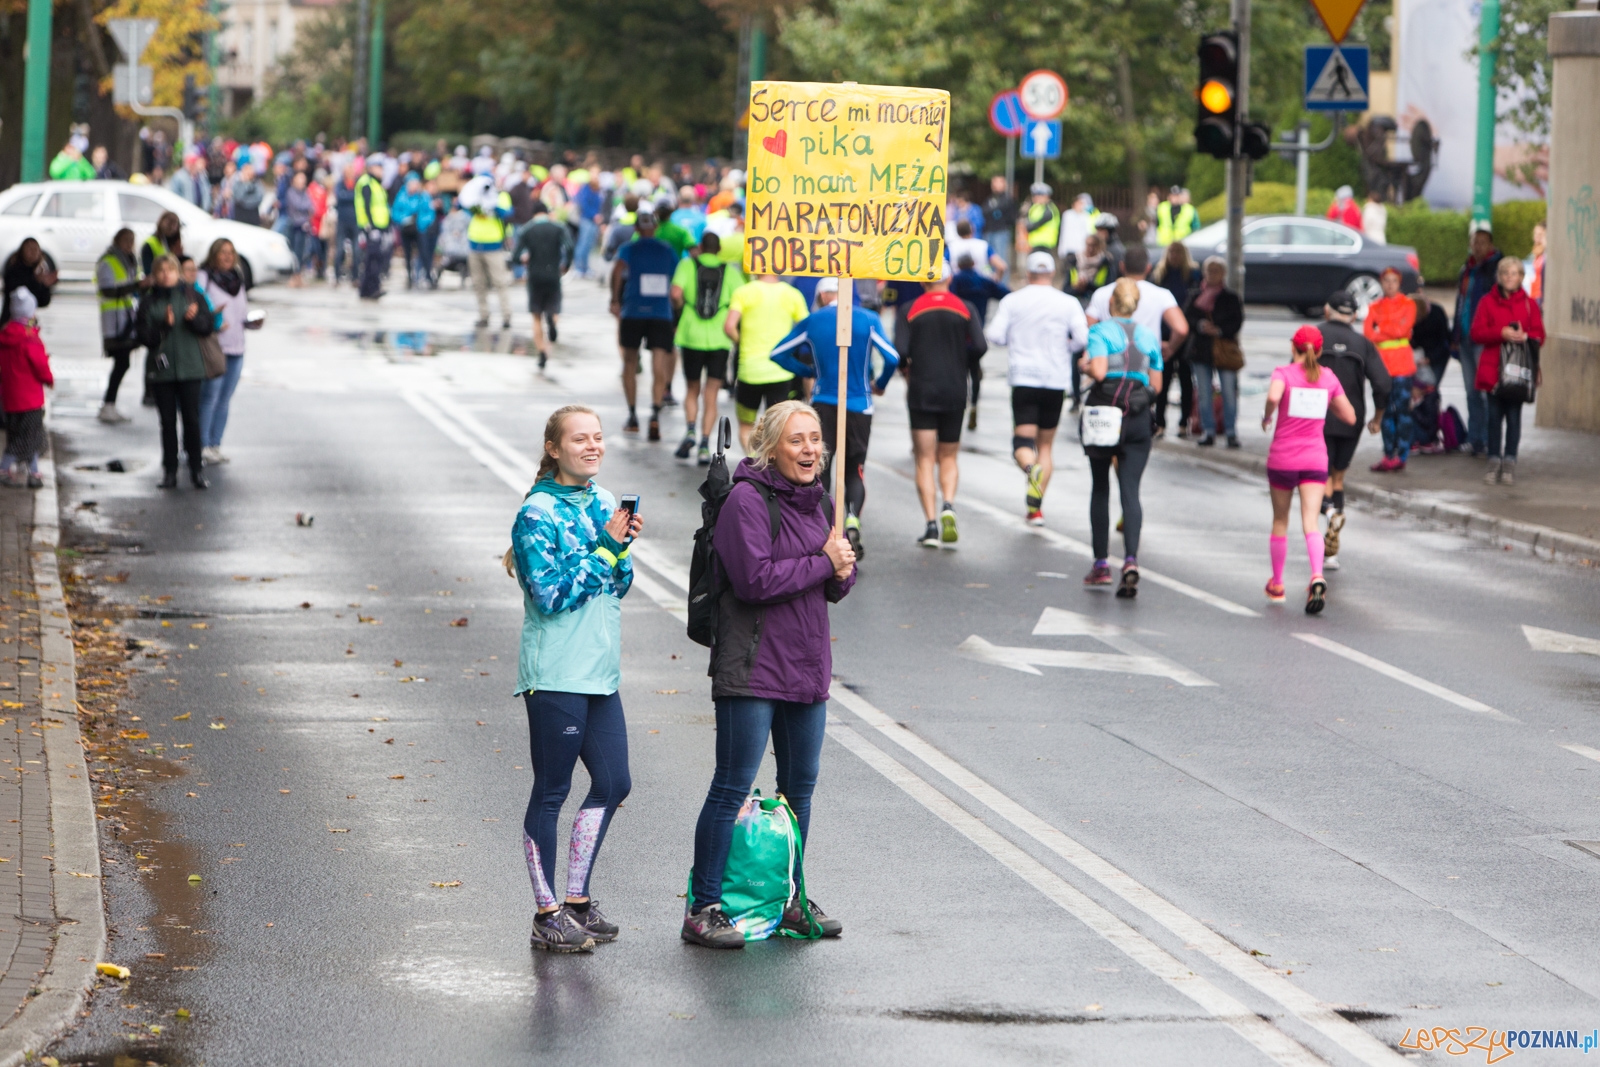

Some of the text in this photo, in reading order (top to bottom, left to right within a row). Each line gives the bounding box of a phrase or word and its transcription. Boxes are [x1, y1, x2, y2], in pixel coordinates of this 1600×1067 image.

[1028, 83, 1061, 107] 50
[752, 89, 947, 152] Serce mi mocniej
[799, 125, 874, 165] pika
[751, 159, 946, 195] bo mam MĘŻA
[751, 198, 946, 239] MARATOŃCZYKA
[748, 236, 941, 280] ROBERT GO!
